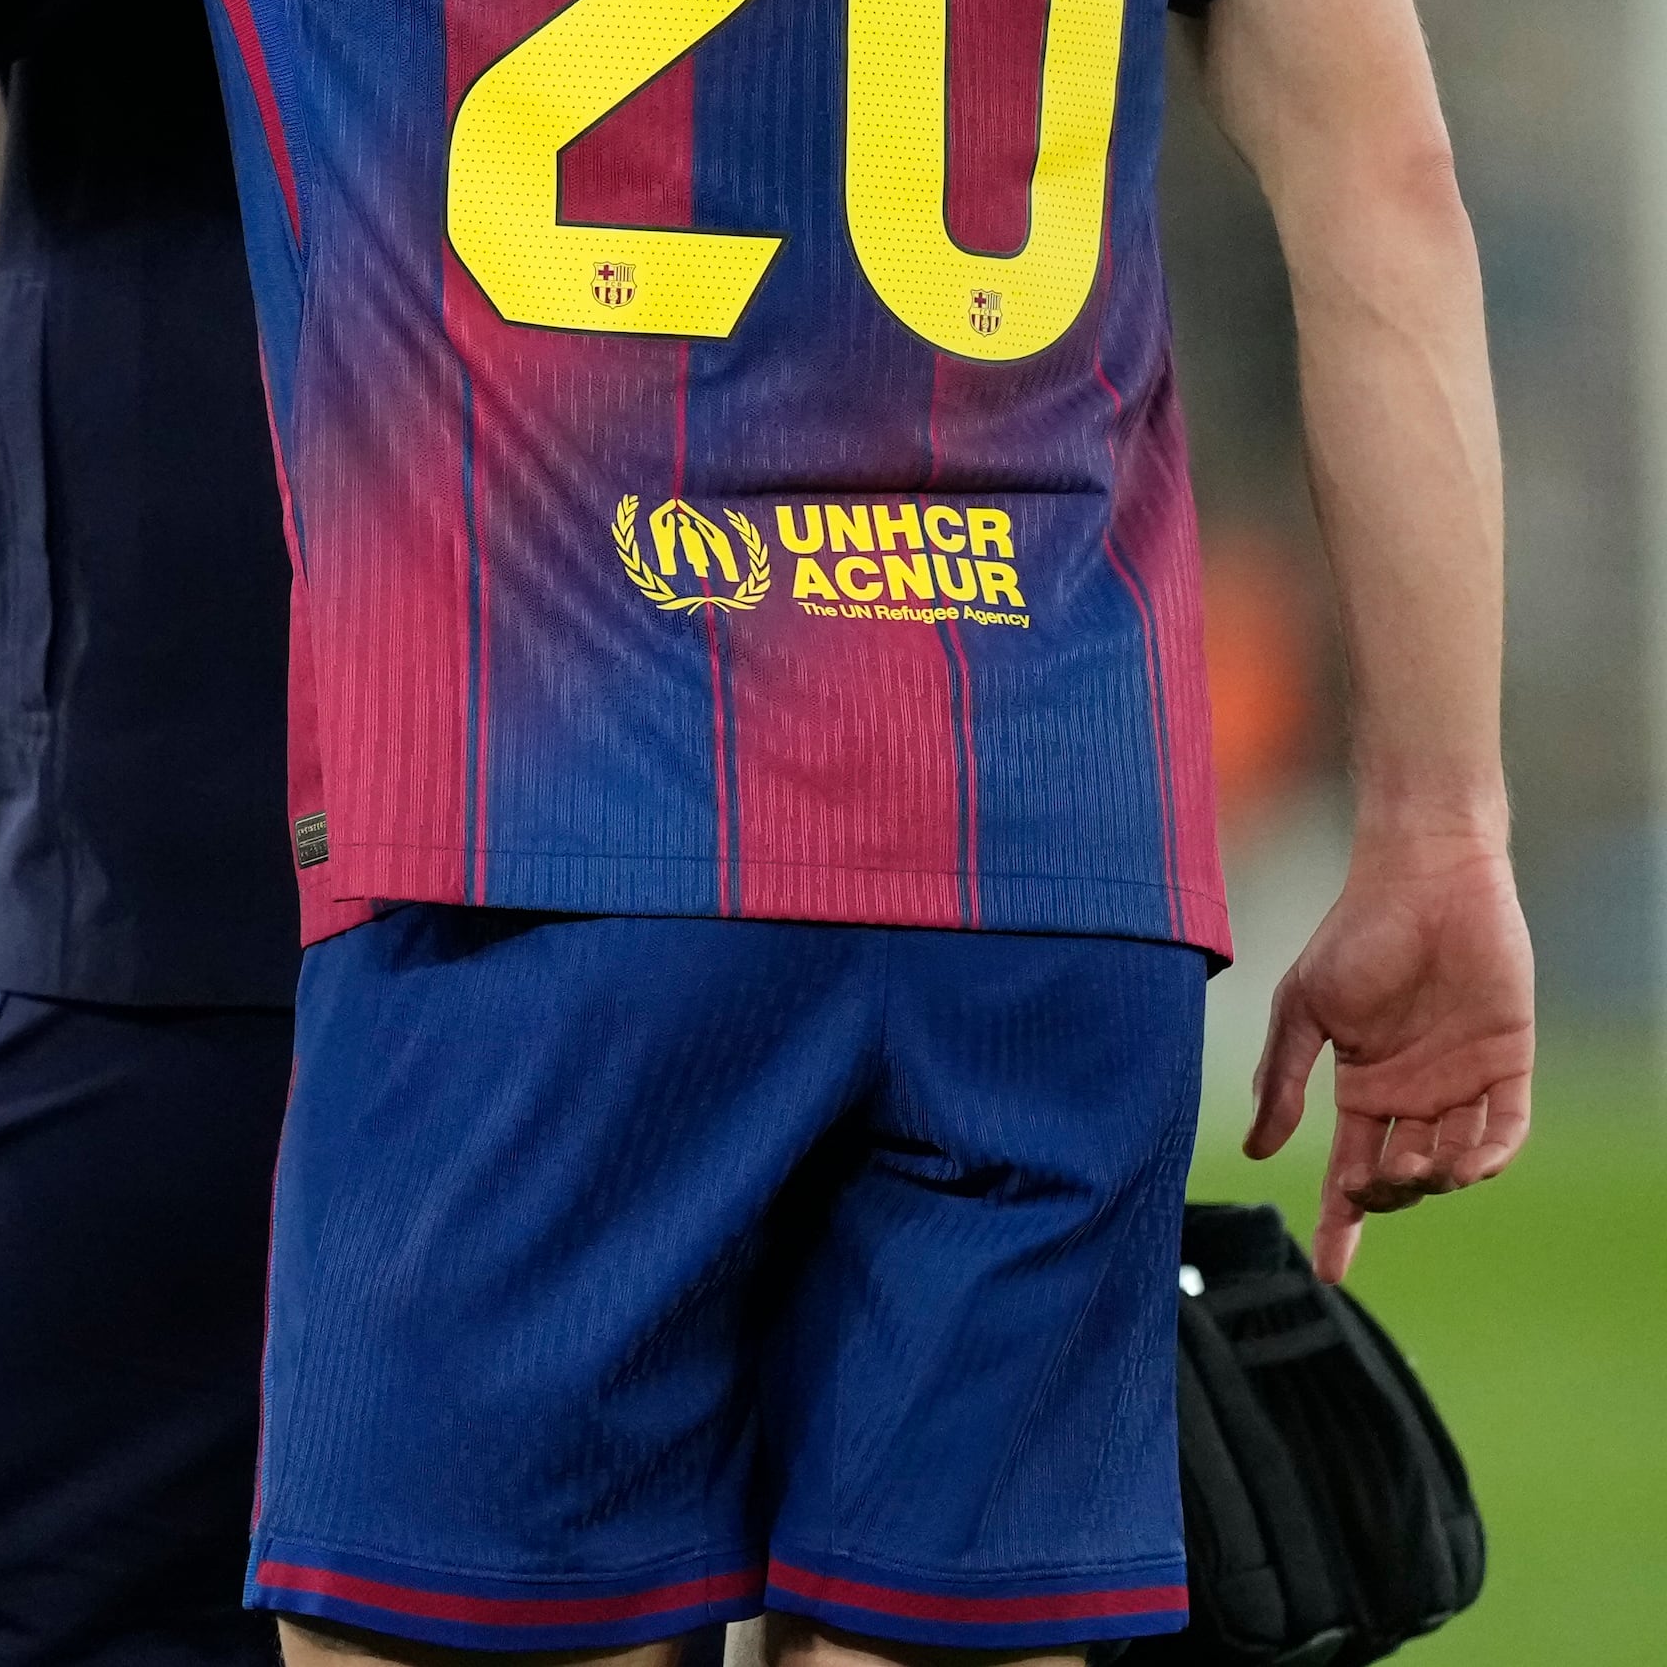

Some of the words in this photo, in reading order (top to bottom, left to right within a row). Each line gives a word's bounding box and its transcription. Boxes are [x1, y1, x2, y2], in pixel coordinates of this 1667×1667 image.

[775, 503, 1015, 559] UNHCR
[792, 554, 1026, 608] ACNUR
[797, 601, 838, 618] The
[839, 604, 873, 620] UN
[874, 605, 960, 625] Refugee
[962, 605, 1030, 629] Agency
